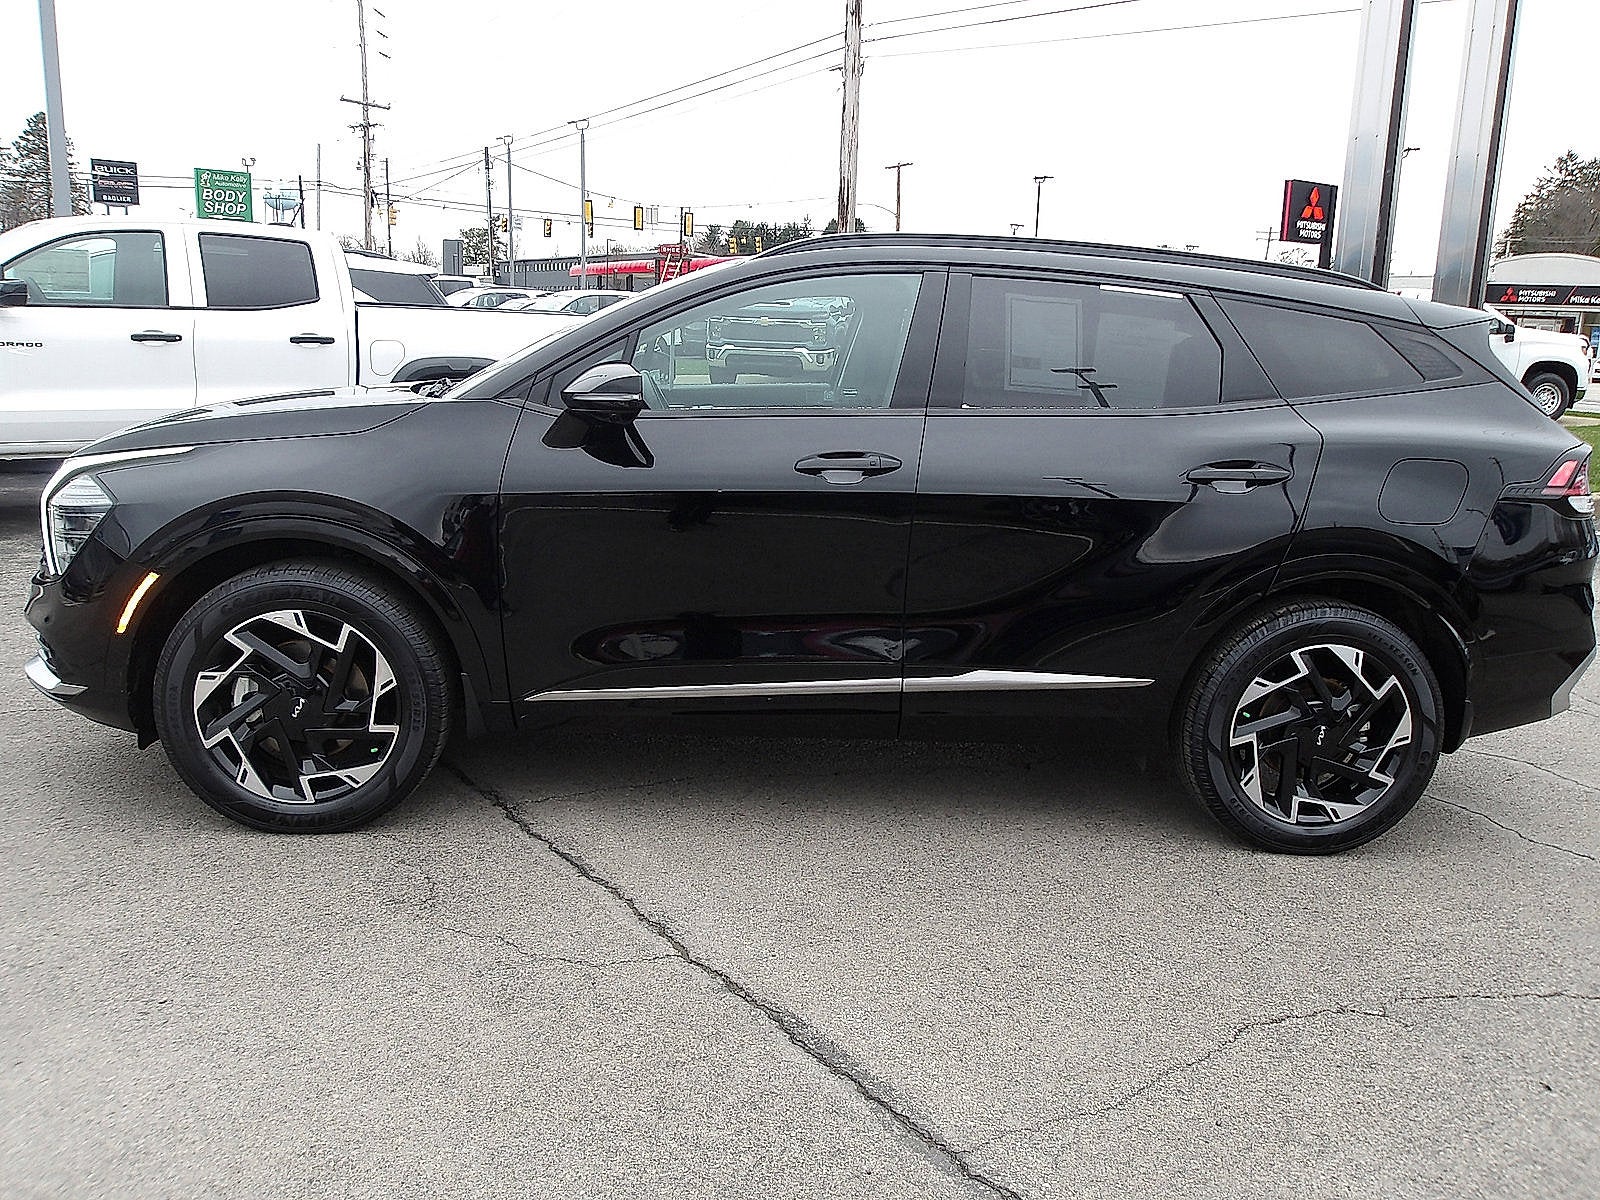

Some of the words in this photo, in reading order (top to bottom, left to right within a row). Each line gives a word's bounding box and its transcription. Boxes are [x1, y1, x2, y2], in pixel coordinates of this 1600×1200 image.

[94, 165, 135, 175] BUICK
[212, 173, 229, 181] Mike
[230, 175, 247, 184] Kelly
[202, 188, 247, 203] BODY
[203, 201, 247, 215] SHOP
[1296, 220, 1326, 231] MITSUBISHI
[1299, 229, 1322, 239] MOTORS
[1518, 289, 1557, 297] MITSUBISHI
